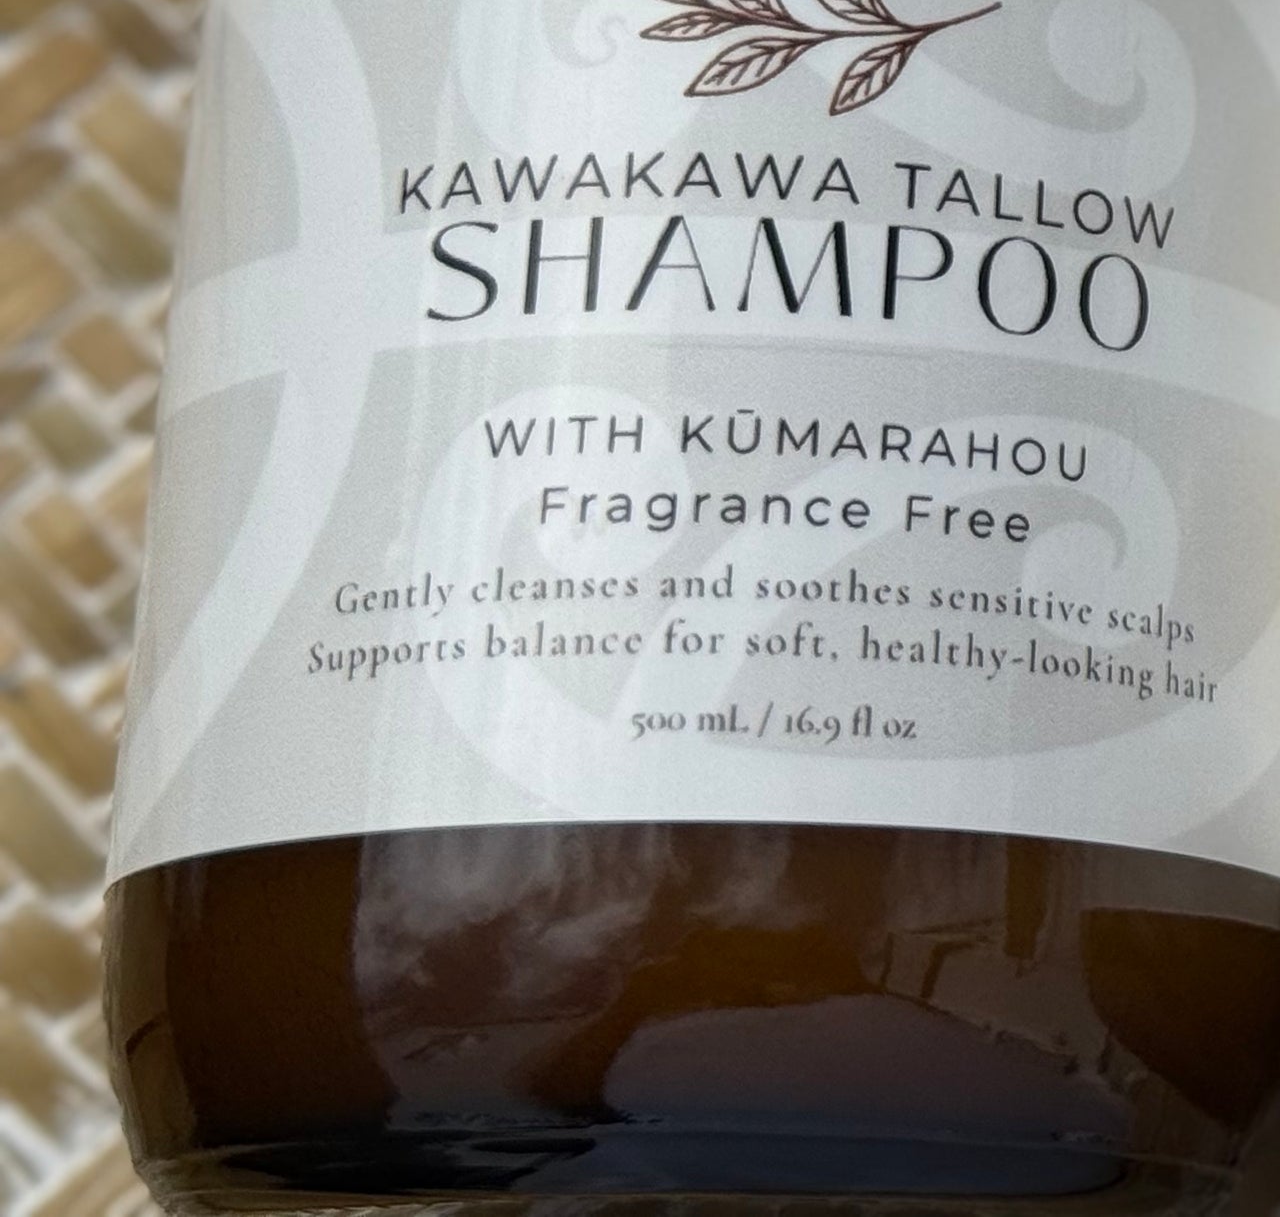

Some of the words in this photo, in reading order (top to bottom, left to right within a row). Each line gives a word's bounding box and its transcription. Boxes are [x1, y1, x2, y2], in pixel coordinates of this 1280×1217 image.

[398, 151, 860, 215] KAWAKAWA
[894, 161, 1174, 251] TALLOW
[426, 213, 1149, 352] SHAMPOO
[484, 415, 644, 459] WITH
[680, 408, 1087, 483] KŪMARAHOU
[539, 486, 871, 534] Fragrance
[904, 494, 1031, 544] Free
[333, 571, 455, 618] Gently
[470, 566, 639, 604] cleanses
[659, 563, 734, 600] and
[755, 567, 911, 607] soothes
[928, 586, 1093, 626] sensitive
[1107, 603, 1195, 653] scalps
[307, 638, 466, 682] Supports
[483, 620, 643, 660] balance
[663, 617, 725, 656] for
[745, 620, 839, 662] soft,
[860, 624, 1154, 702] healthy-looking
[1164, 658, 1218, 704] hair
[630, 711, 687, 742] 500
[697, 703, 750, 734] mL
[755, 700, 775, 740] /
[784, 705, 842, 746] 16.9
[851, 704, 873, 738] fl
[881, 718, 918, 741] oz
